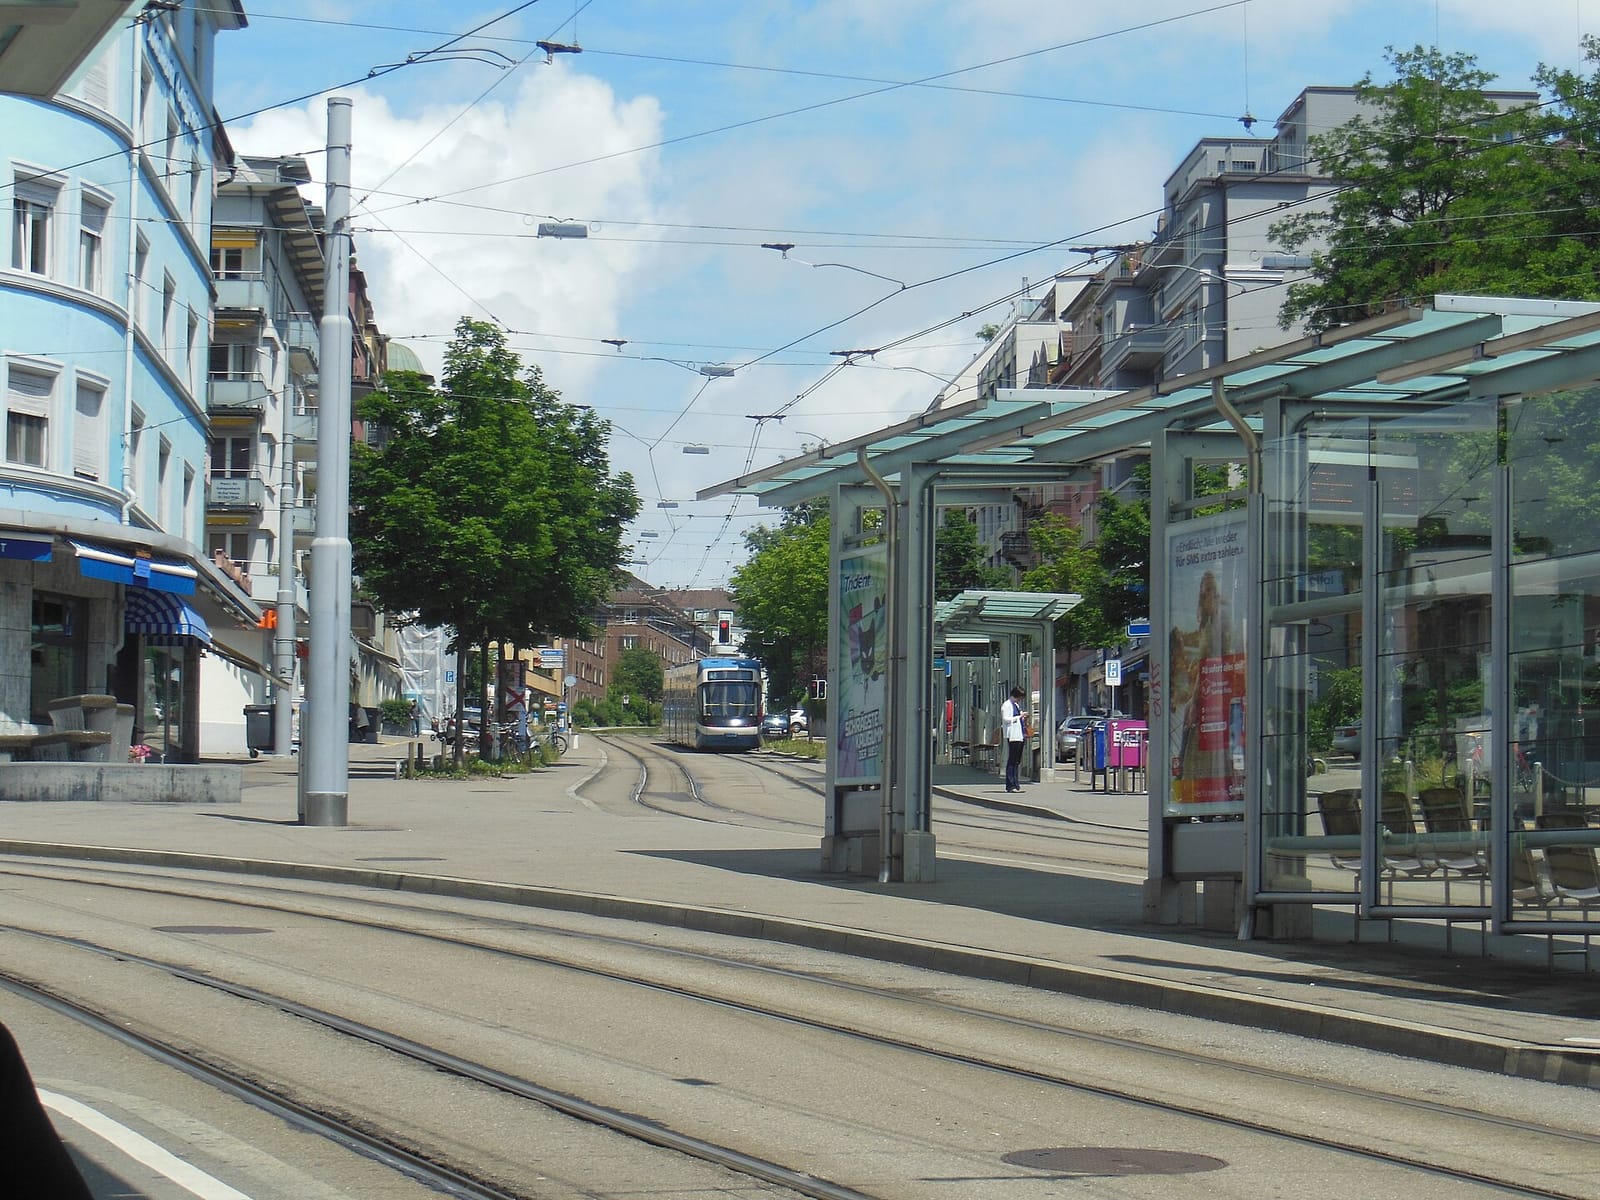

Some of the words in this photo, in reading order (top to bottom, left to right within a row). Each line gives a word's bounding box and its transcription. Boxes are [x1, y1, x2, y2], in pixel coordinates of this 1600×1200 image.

[1186, 552, 1200, 566] SMS
[1200, 550, 1217, 563] extra
[844, 574, 872, 592] Trident
